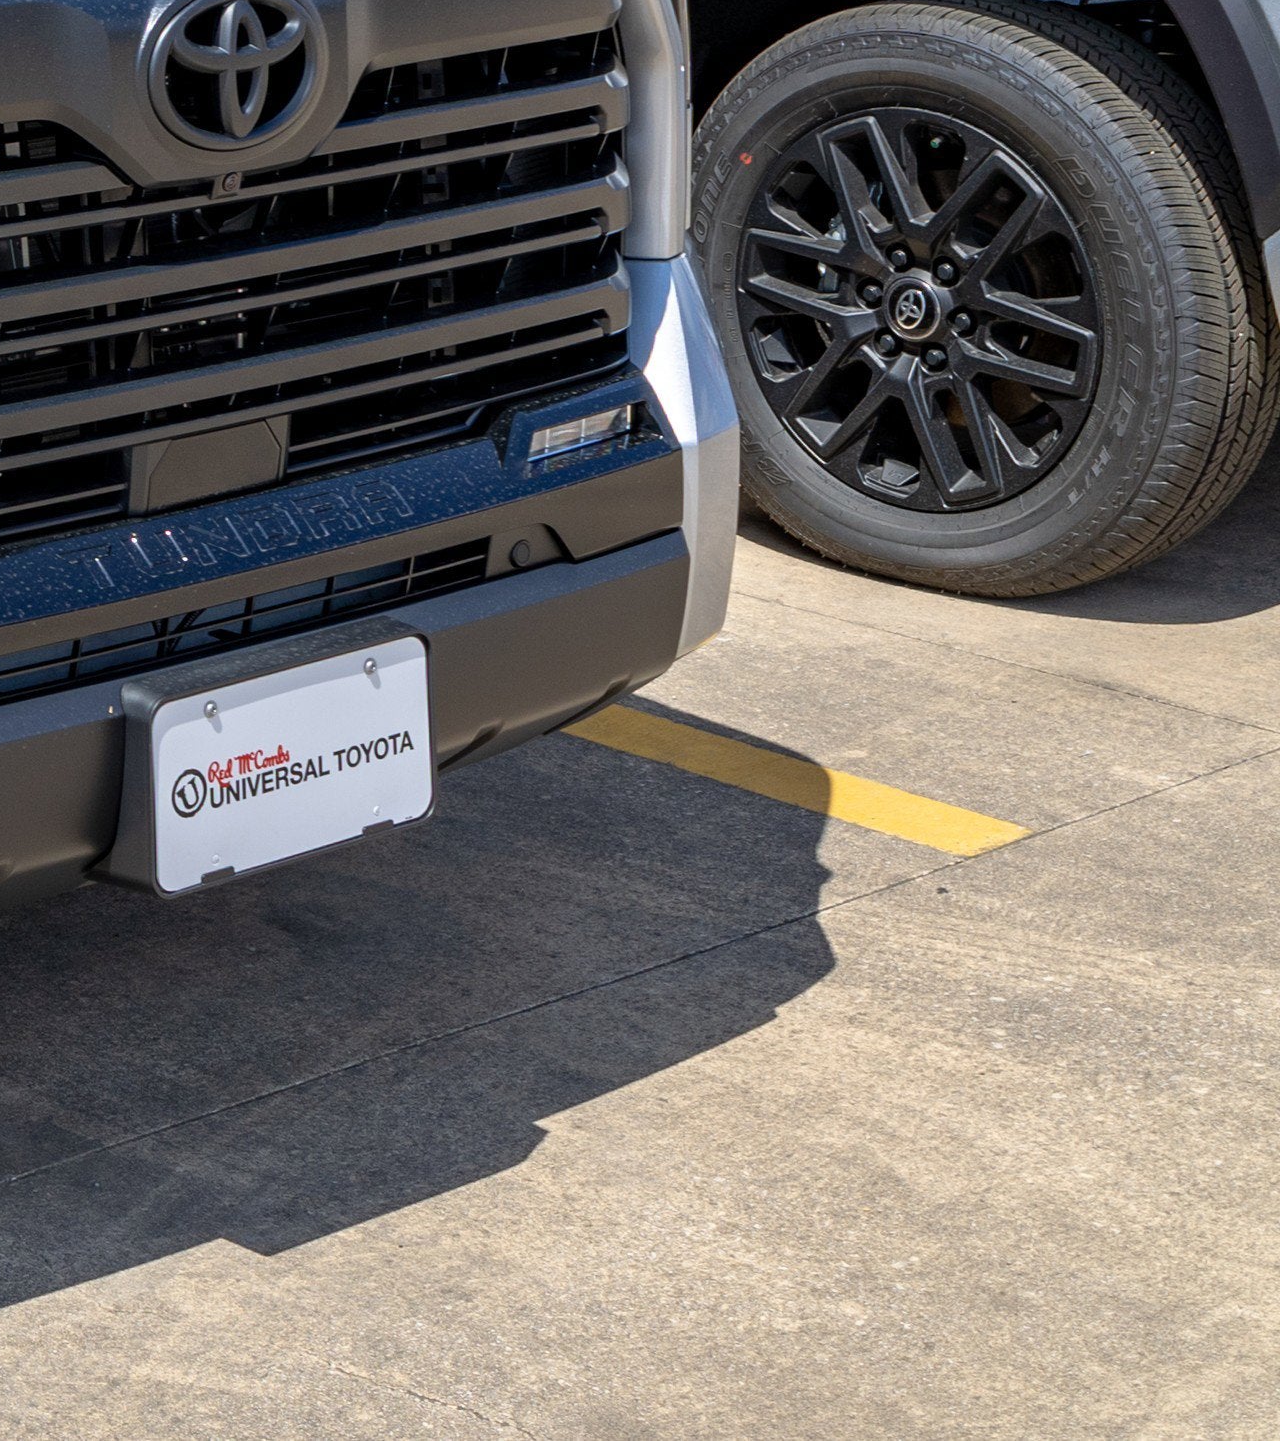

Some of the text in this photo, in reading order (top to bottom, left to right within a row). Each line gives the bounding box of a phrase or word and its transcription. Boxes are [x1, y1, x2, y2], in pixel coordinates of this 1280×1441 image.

[54, 479, 414, 589] TUNDRA
[207, 759, 233, 787] Red
[209, 730, 415, 808] UNIVERSAL TOYOTA
